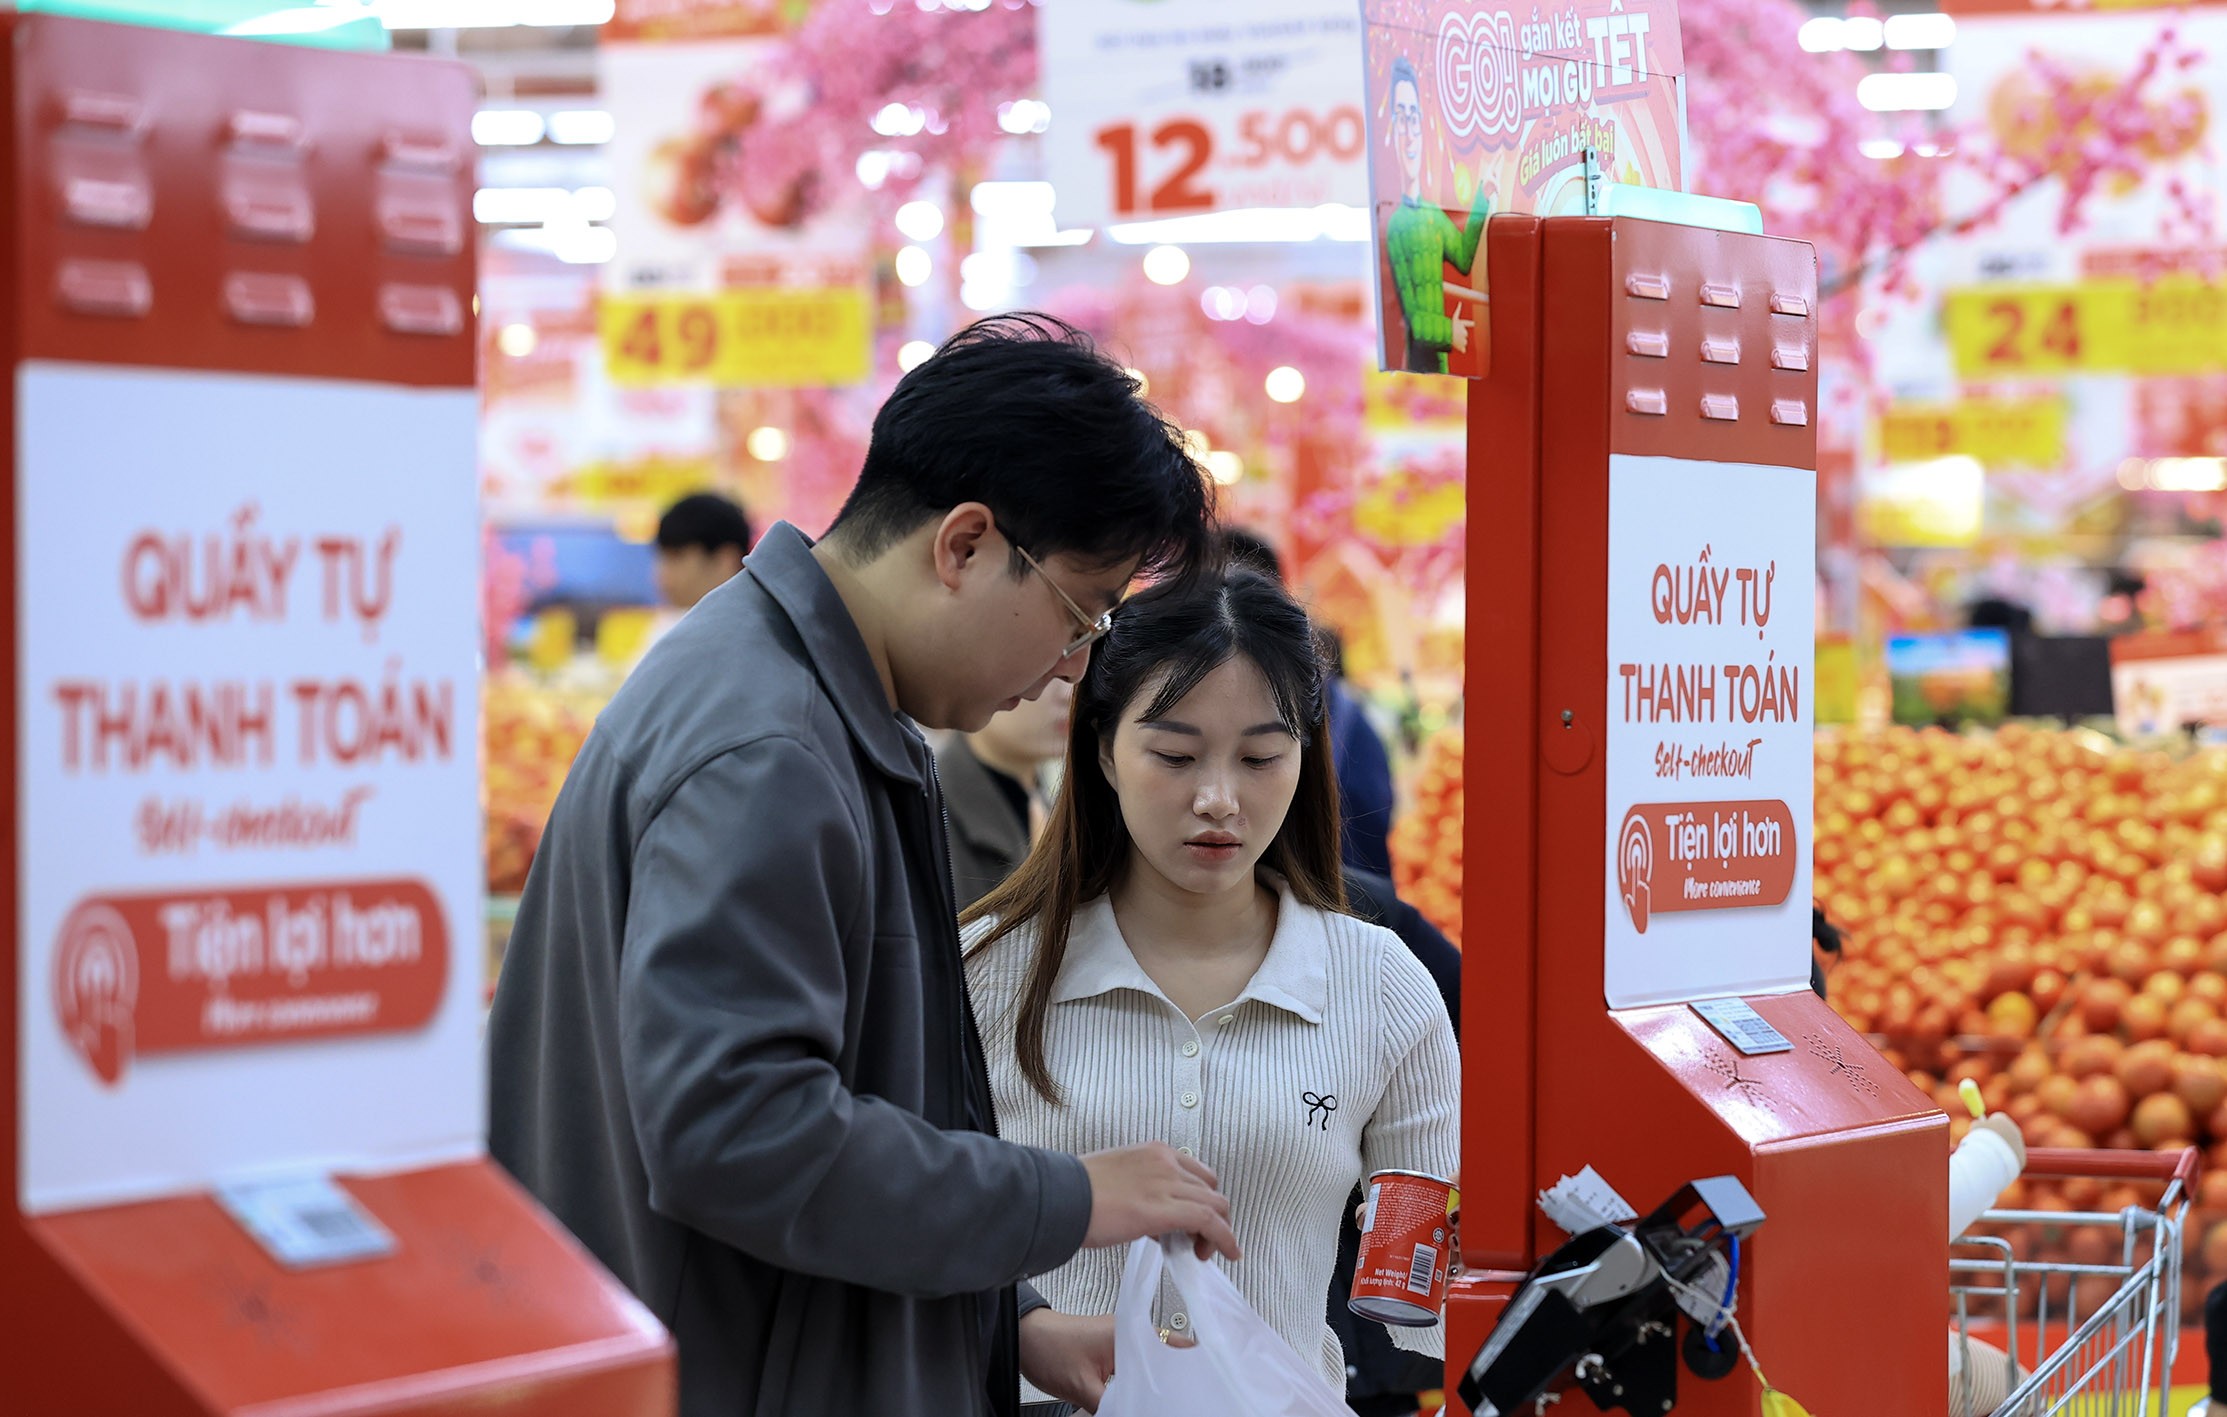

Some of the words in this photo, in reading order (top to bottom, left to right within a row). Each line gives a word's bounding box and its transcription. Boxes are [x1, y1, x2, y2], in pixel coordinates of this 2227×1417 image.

[1520, 6, 1552, 61] gắn
[1554, 6, 1583, 50] kết
[1436, 11, 1522, 137] GO!
[1521, 63, 1561, 117] MỌI
[1520, 143, 1539, 187] Giá
[1541, 130, 1568, 168] luôn
[1571, 118, 1591, 155] bất
[1595, 123, 1614, 160] bại
[317, 524, 403, 643] TỰ
[1652, 543, 1729, 625] QUẦY
[1736, 560, 1775, 640] TỰ
[54, 676, 273, 770] THANH
[293, 653, 454, 765] TOÁN
[1619, 663, 1715, 723] THANH
[1723, 649, 1798, 724] TOÁN
[1655, 738, 1762, 781] Self-checkout
[1665, 811, 1709, 871] Tiện
[1713, 811, 1738, 869] lợi
[1743, 810, 1781, 857] hơn
[1684, 877, 1707, 899] More
[1709, 879, 1761, 898] convenience
[161, 898, 263, 996] Tiện
[332, 894, 422, 970] hơn
